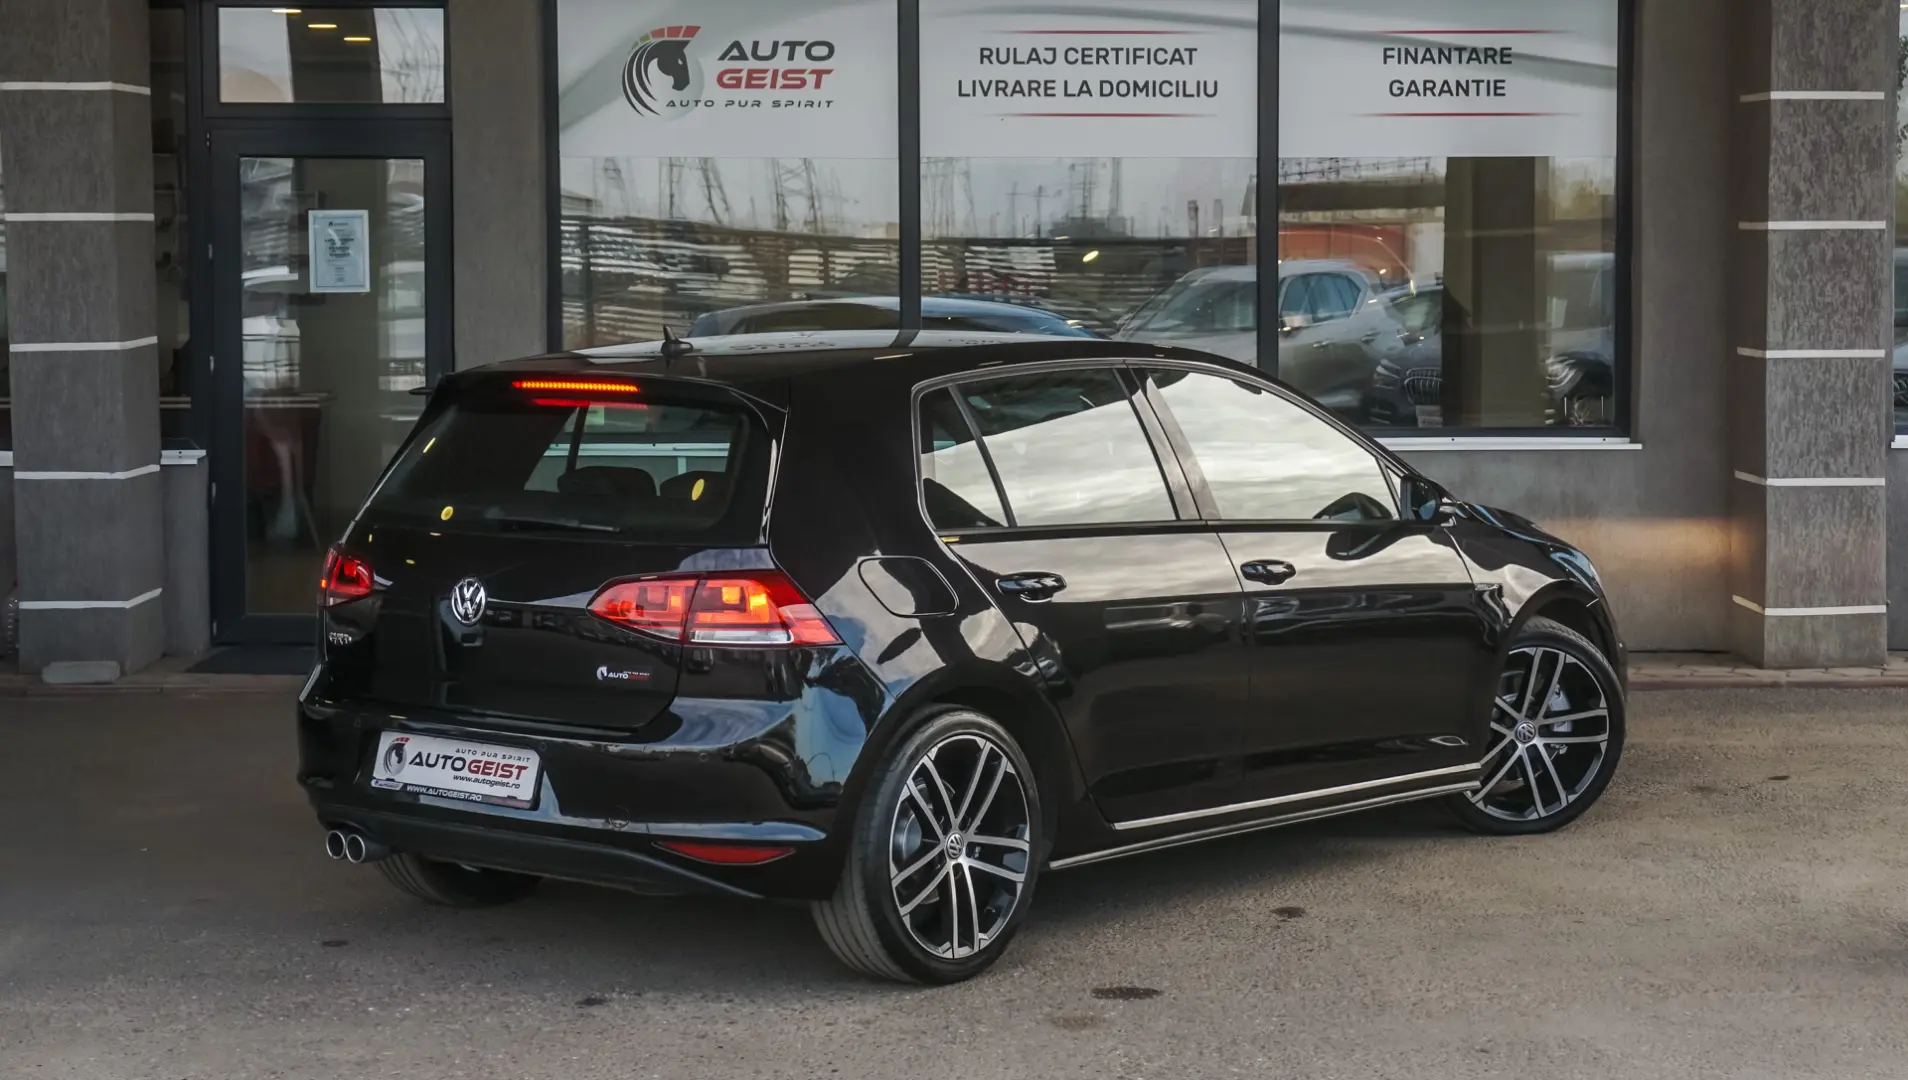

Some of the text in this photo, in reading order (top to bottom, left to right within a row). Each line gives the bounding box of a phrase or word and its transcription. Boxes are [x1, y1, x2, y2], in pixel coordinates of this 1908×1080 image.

[717, 40, 835, 62] AUTO
[979, 47, 1198, 66] RULAJ CERTIFICAT
[1382, 46, 1513, 65] FINANTARE
[716, 68, 835, 90] GEIST
[957, 79, 1219, 98] LIVRARE LA DOMICILIU
[1388, 79, 1507, 98] GARANTIE
[666, 99, 835, 109] AUTO PUR SPIRIT
[455, 747, 531, 763] AUTO PUR SPIRIT
[453, 774, 521, 790] www.autogeist.ro
[406, 783, 483, 802] WWW.AUTOGEIST.RO
